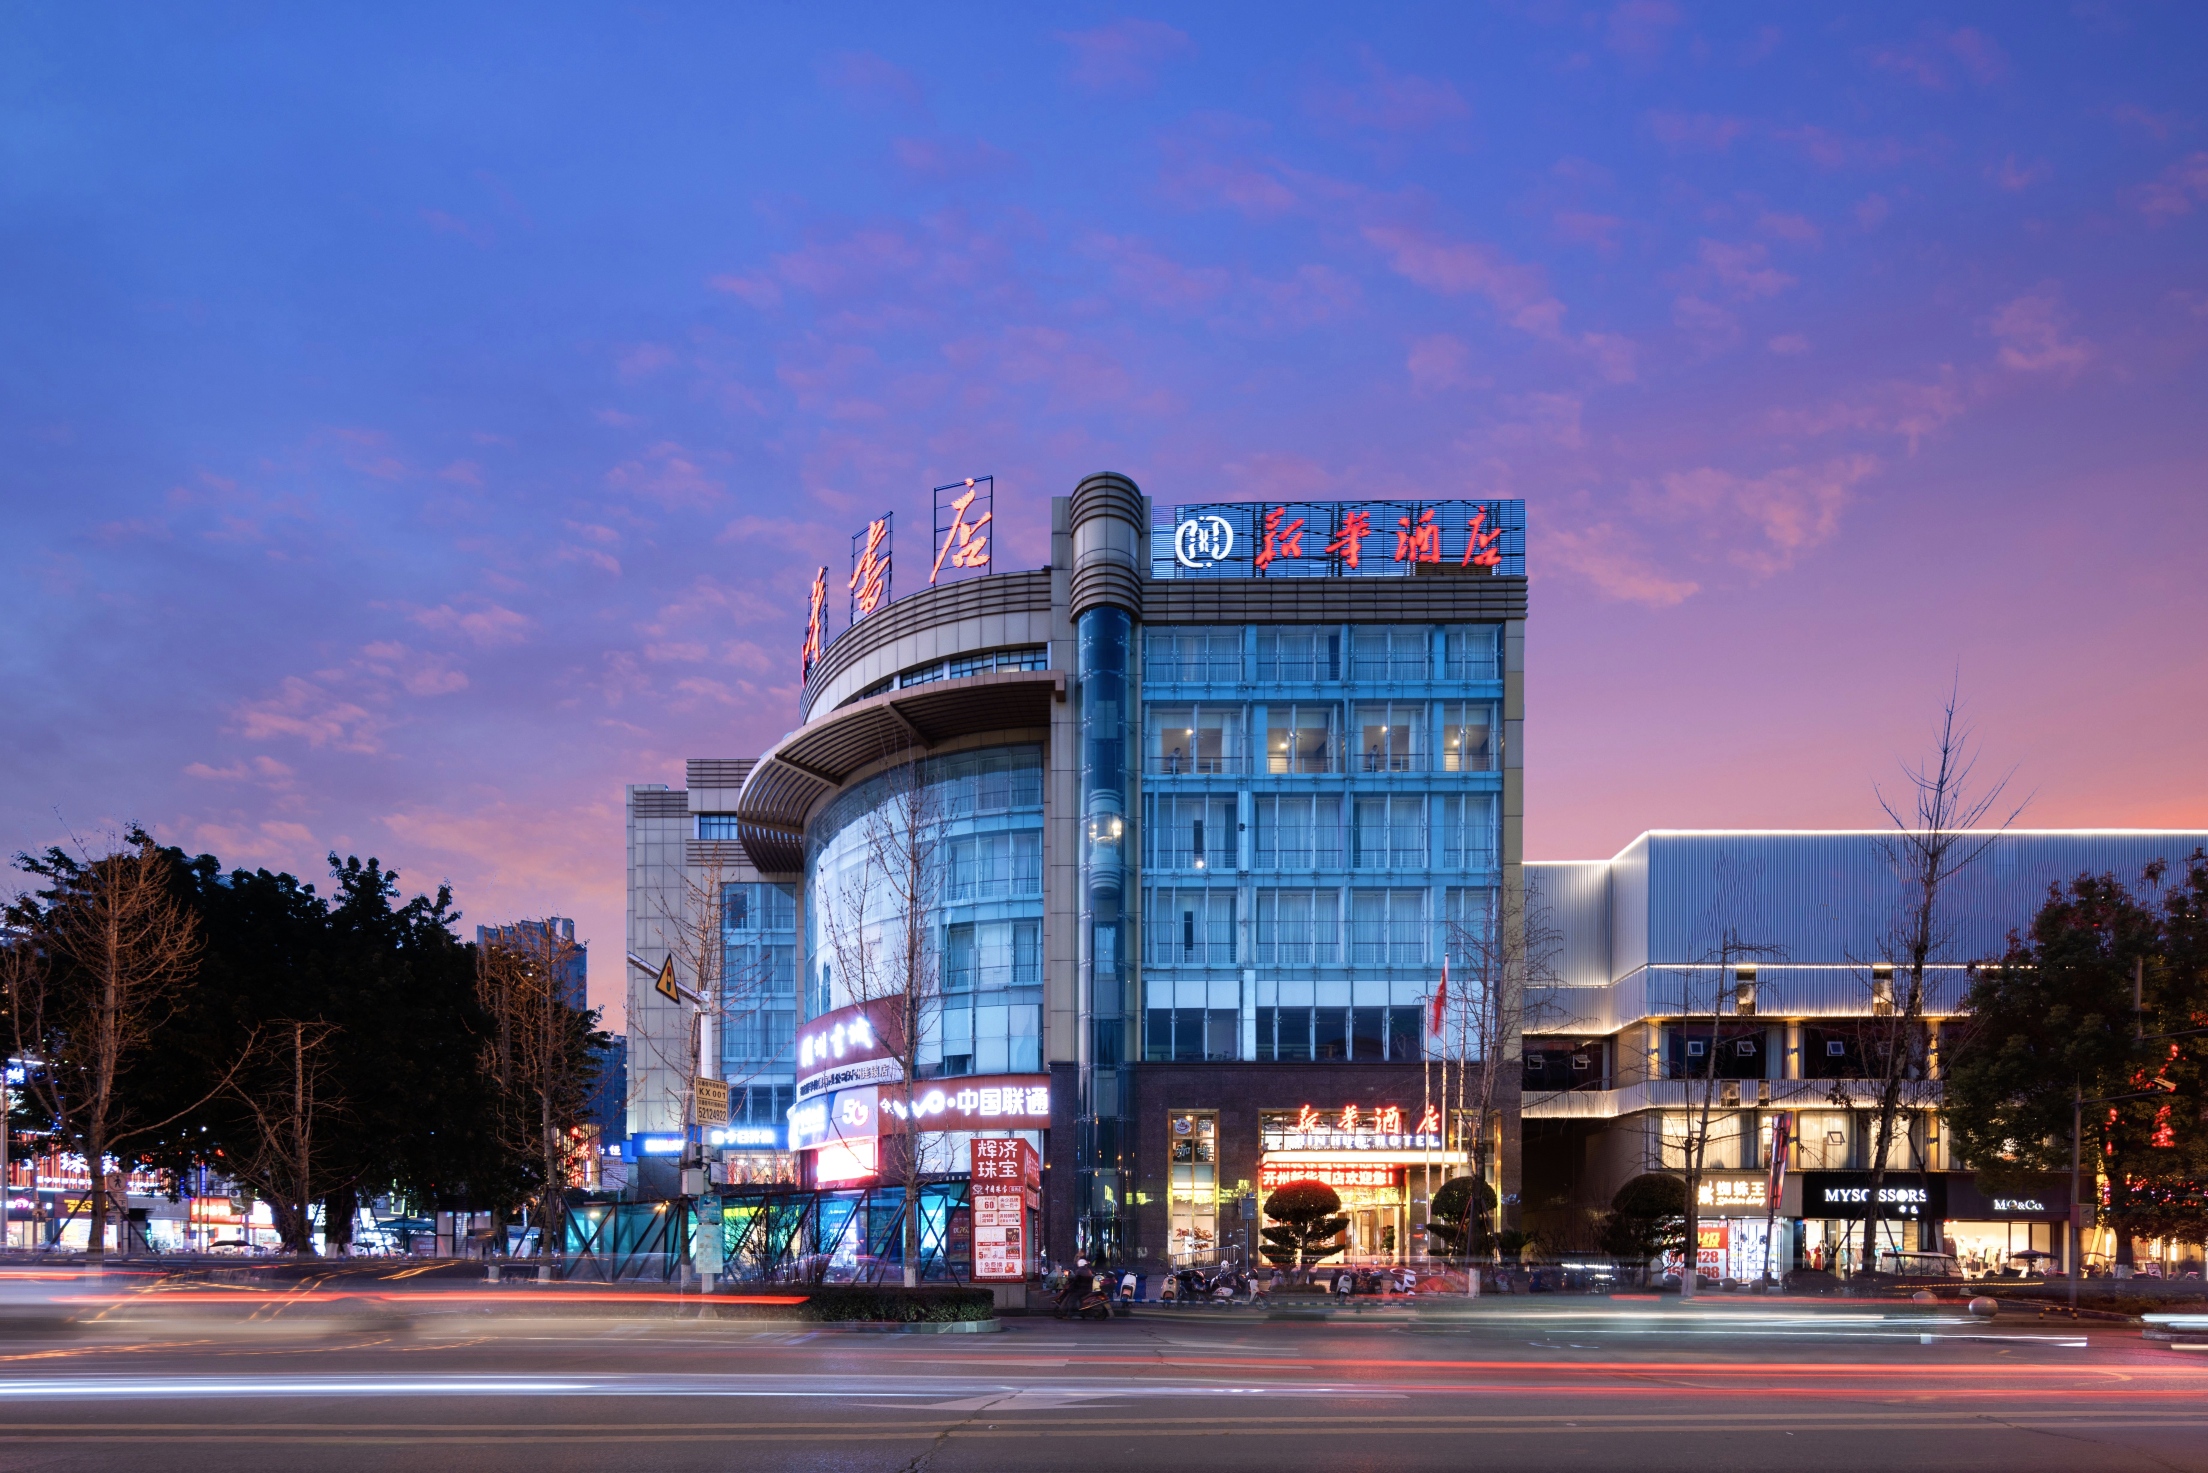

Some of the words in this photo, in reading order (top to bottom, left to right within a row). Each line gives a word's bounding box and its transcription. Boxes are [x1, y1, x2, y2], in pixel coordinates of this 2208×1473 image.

[957, 1086, 1049, 1117] 中国联通
[698, 1106, 727, 1121] 52124922
[1374, 1135, 1441, 1147] HOTEL
[977, 1139, 1018, 1158] 辉济
[977, 1159, 1018, 1179] 珠宝
[1716, 1181, 1766, 1197] 蜘蛛王
[1824, 1188, 1927, 1202] MYSCSSORS
[984, 1201, 995, 1210] 60
[1993, 1198, 2044, 1211] MO&Co.
[1697, 1250, 1719, 1264] 128
